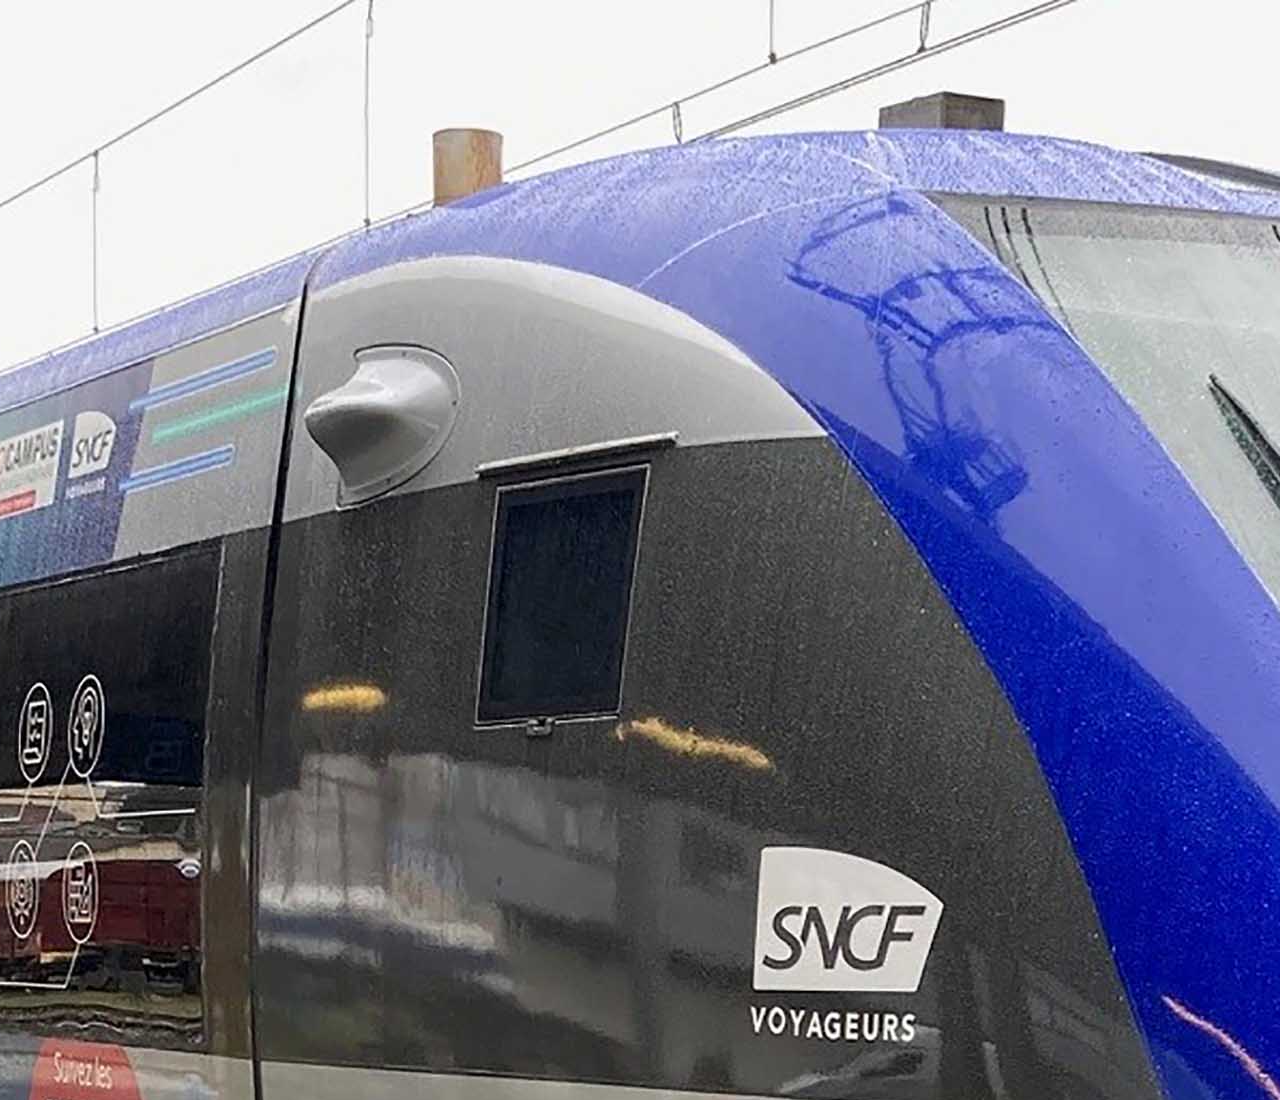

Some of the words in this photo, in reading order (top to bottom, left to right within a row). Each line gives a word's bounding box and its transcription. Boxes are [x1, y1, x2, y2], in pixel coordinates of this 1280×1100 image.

[72, 430, 113, 468] SNCF
[762, 905, 926, 971] SNCF
[750, 1006, 916, 1042] VOYAGEURS
[53, 1051, 93, 1087] Suivez
[95, 1057, 113, 1089] les
